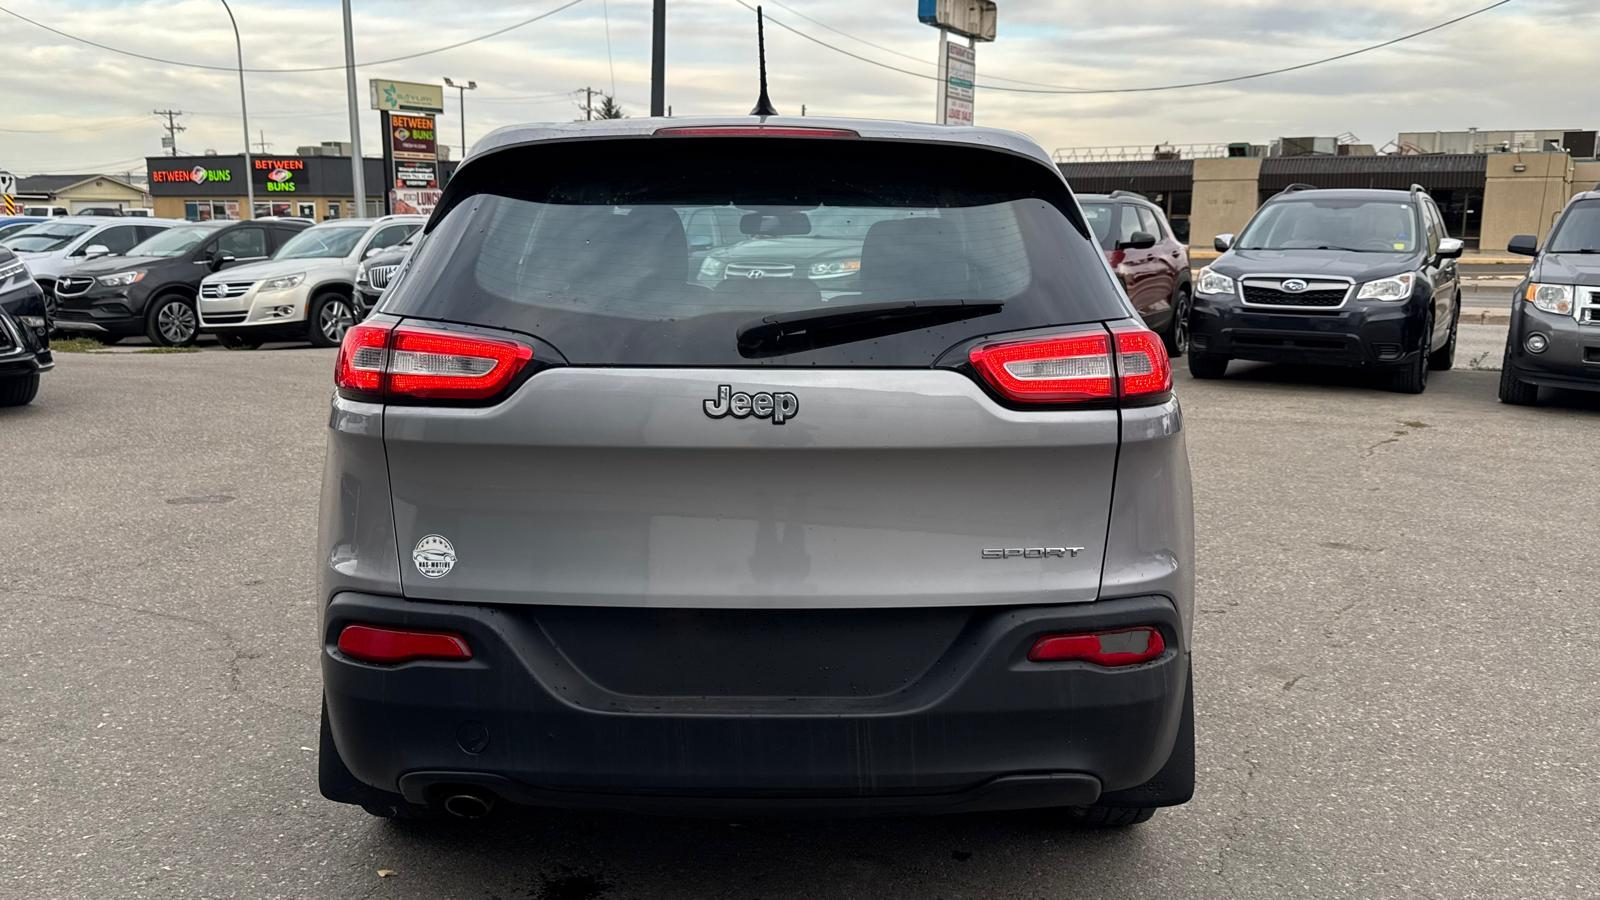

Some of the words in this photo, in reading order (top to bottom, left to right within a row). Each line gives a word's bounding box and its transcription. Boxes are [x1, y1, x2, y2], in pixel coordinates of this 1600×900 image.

[393, 116, 433, 128] BETWEEN
[413, 129, 433, 140] BUNS
[255, 160, 304, 170] BETWEEN
[152, 170, 190, 182] BETWEEN
[208, 169, 231, 181] BUNS
[267, 182, 296, 192] BUNS
[703, 384, 799, 425] Jeep
[981, 546, 1085, 560] SPORT
